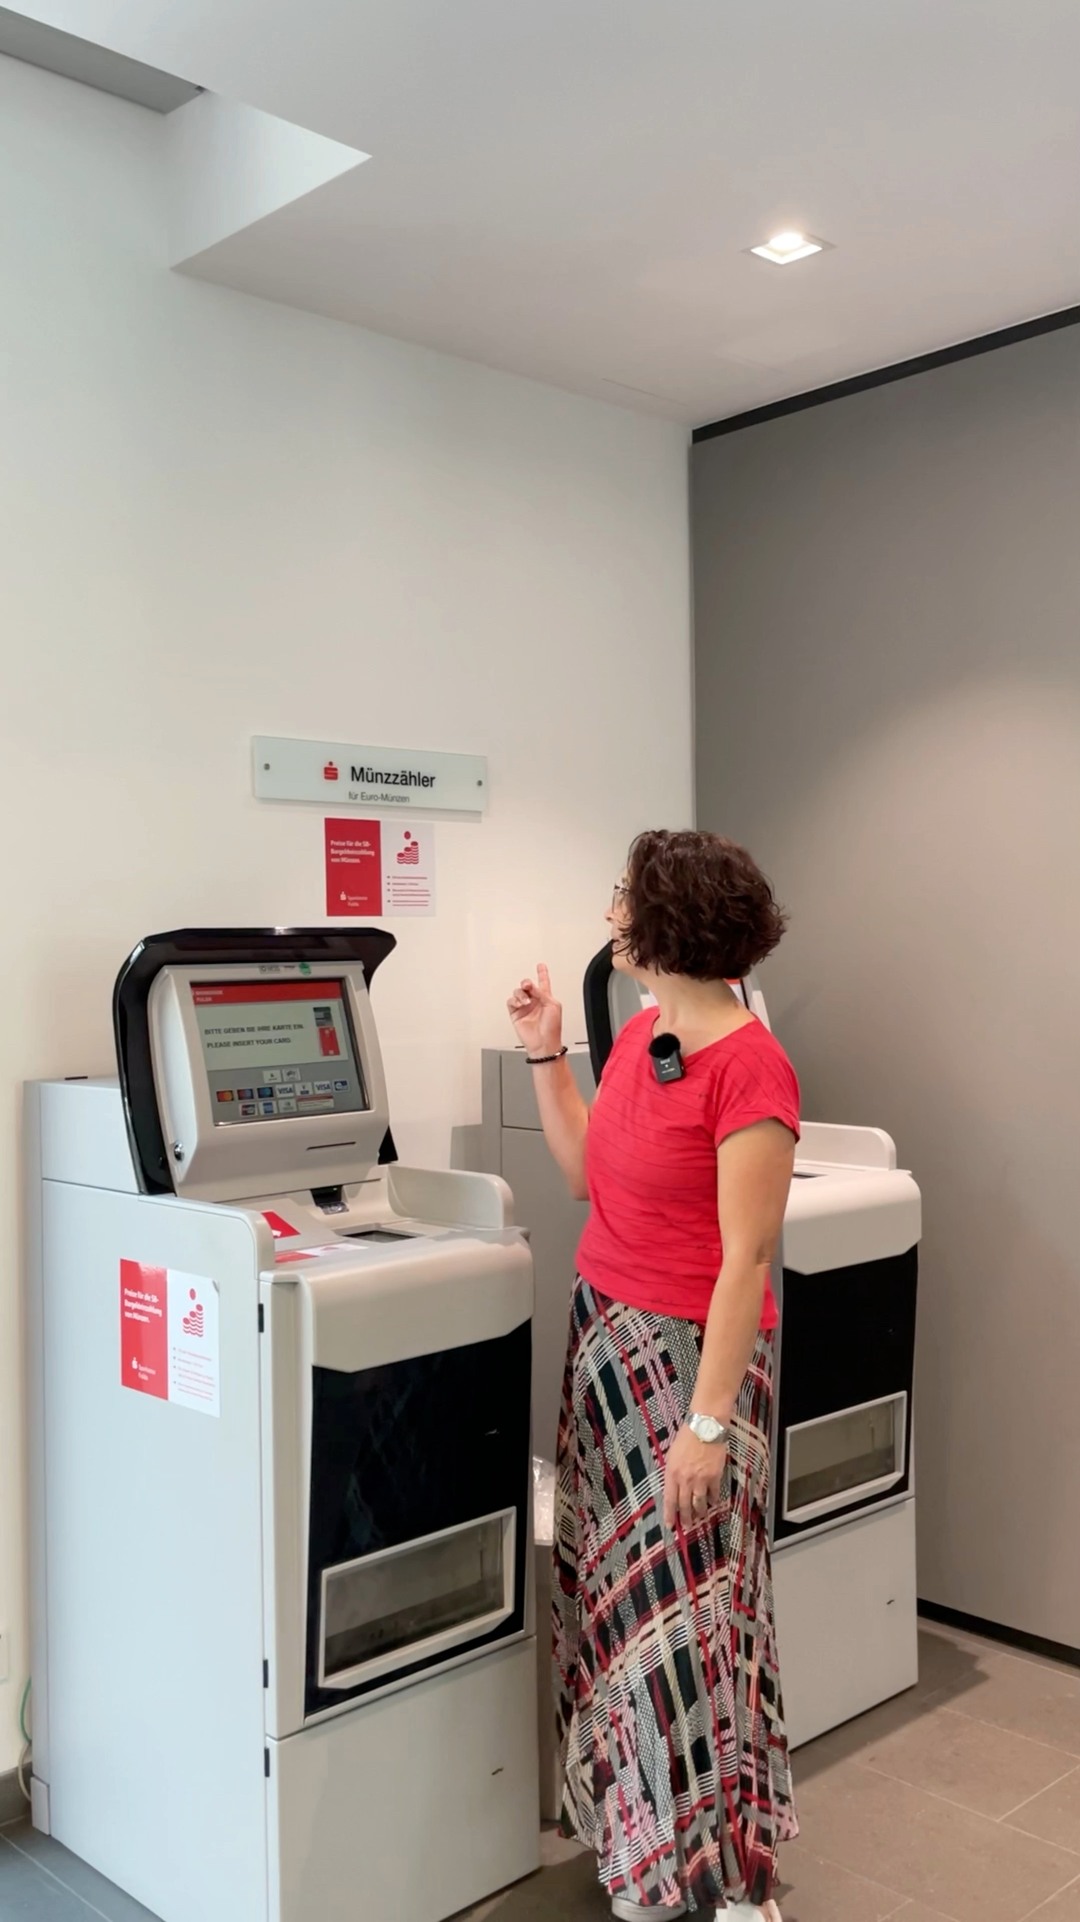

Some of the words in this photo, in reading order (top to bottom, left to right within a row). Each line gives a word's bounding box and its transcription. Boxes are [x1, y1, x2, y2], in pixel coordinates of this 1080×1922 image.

[350, 766, 436, 788] Münzzähler
[348, 791, 359, 800] für
[360, 791, 410, 803] Euro-Münzen
[206, 1041, 231, 1049] PLEASE
[232, 1039, 254, 1047] INSERT
[255, 1038, 272, 1046] YOUR
